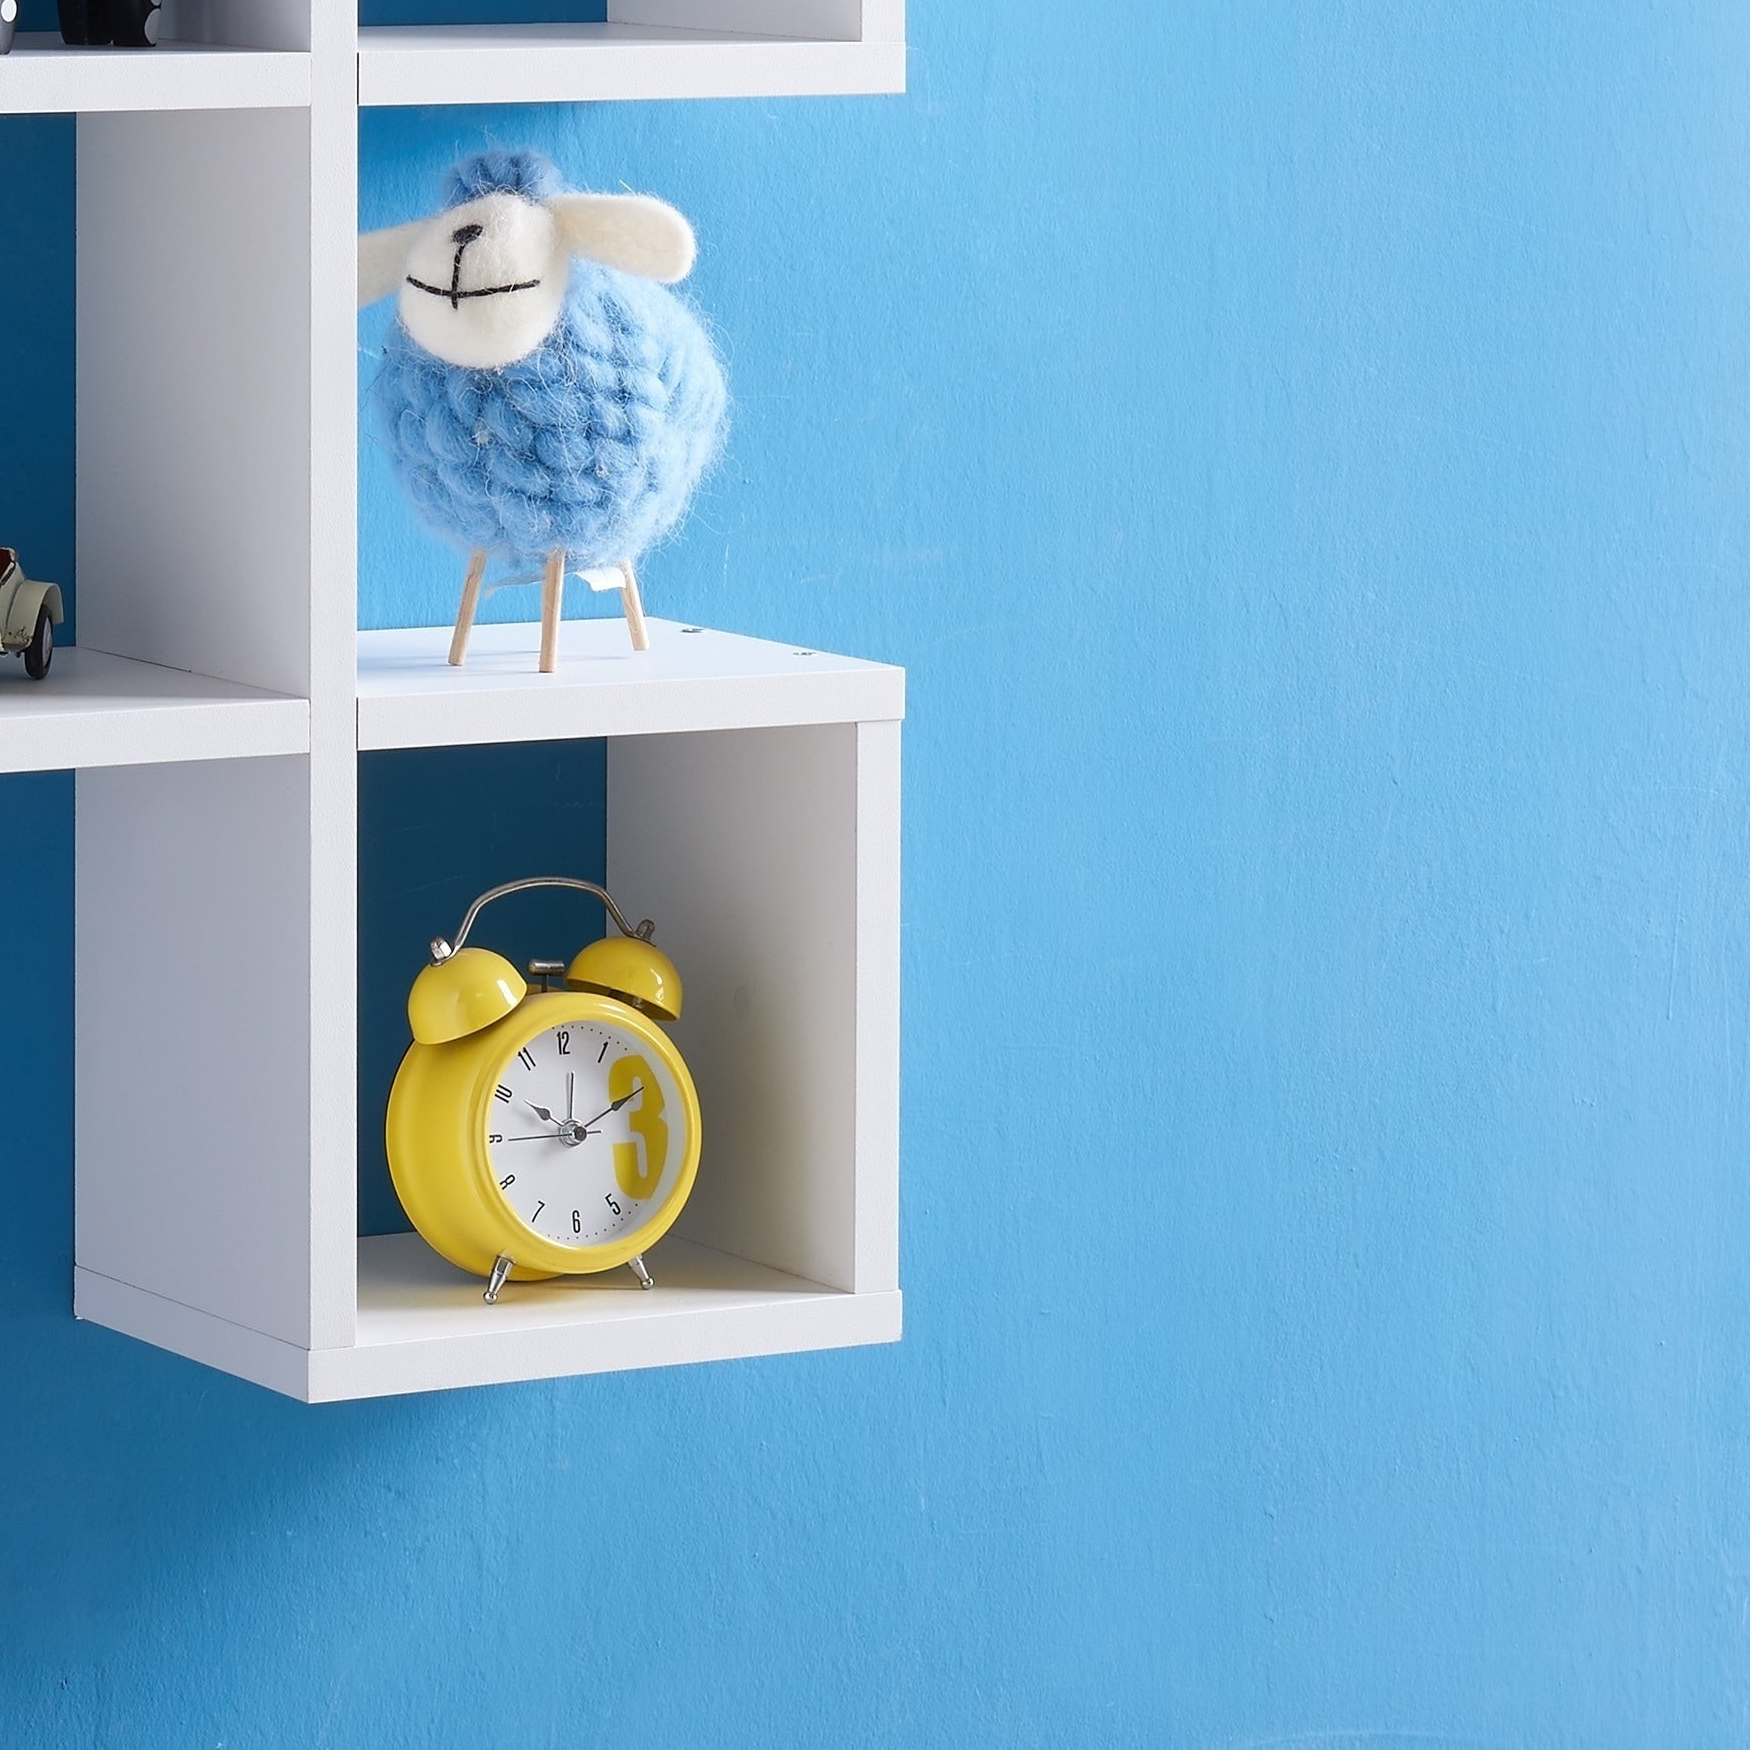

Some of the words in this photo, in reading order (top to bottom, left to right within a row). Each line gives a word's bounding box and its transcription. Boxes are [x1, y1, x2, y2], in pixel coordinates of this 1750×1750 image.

[557, 1031, 570, 1055] 12
[598, 1041, 609, 1063] 1
[517, 1047, 536, 1071] 11
[494, 1084, 513, 1104] 10
[608, 1054, 669, 1200] 3
[489, 1133, 503, 1144] 9
[499, 1174, 516, 1191] 8
[531, 1200, 545, 1223] 7
[605, 1193, 621, 1215] 5
[572, 1210, 581, 1234] 6
